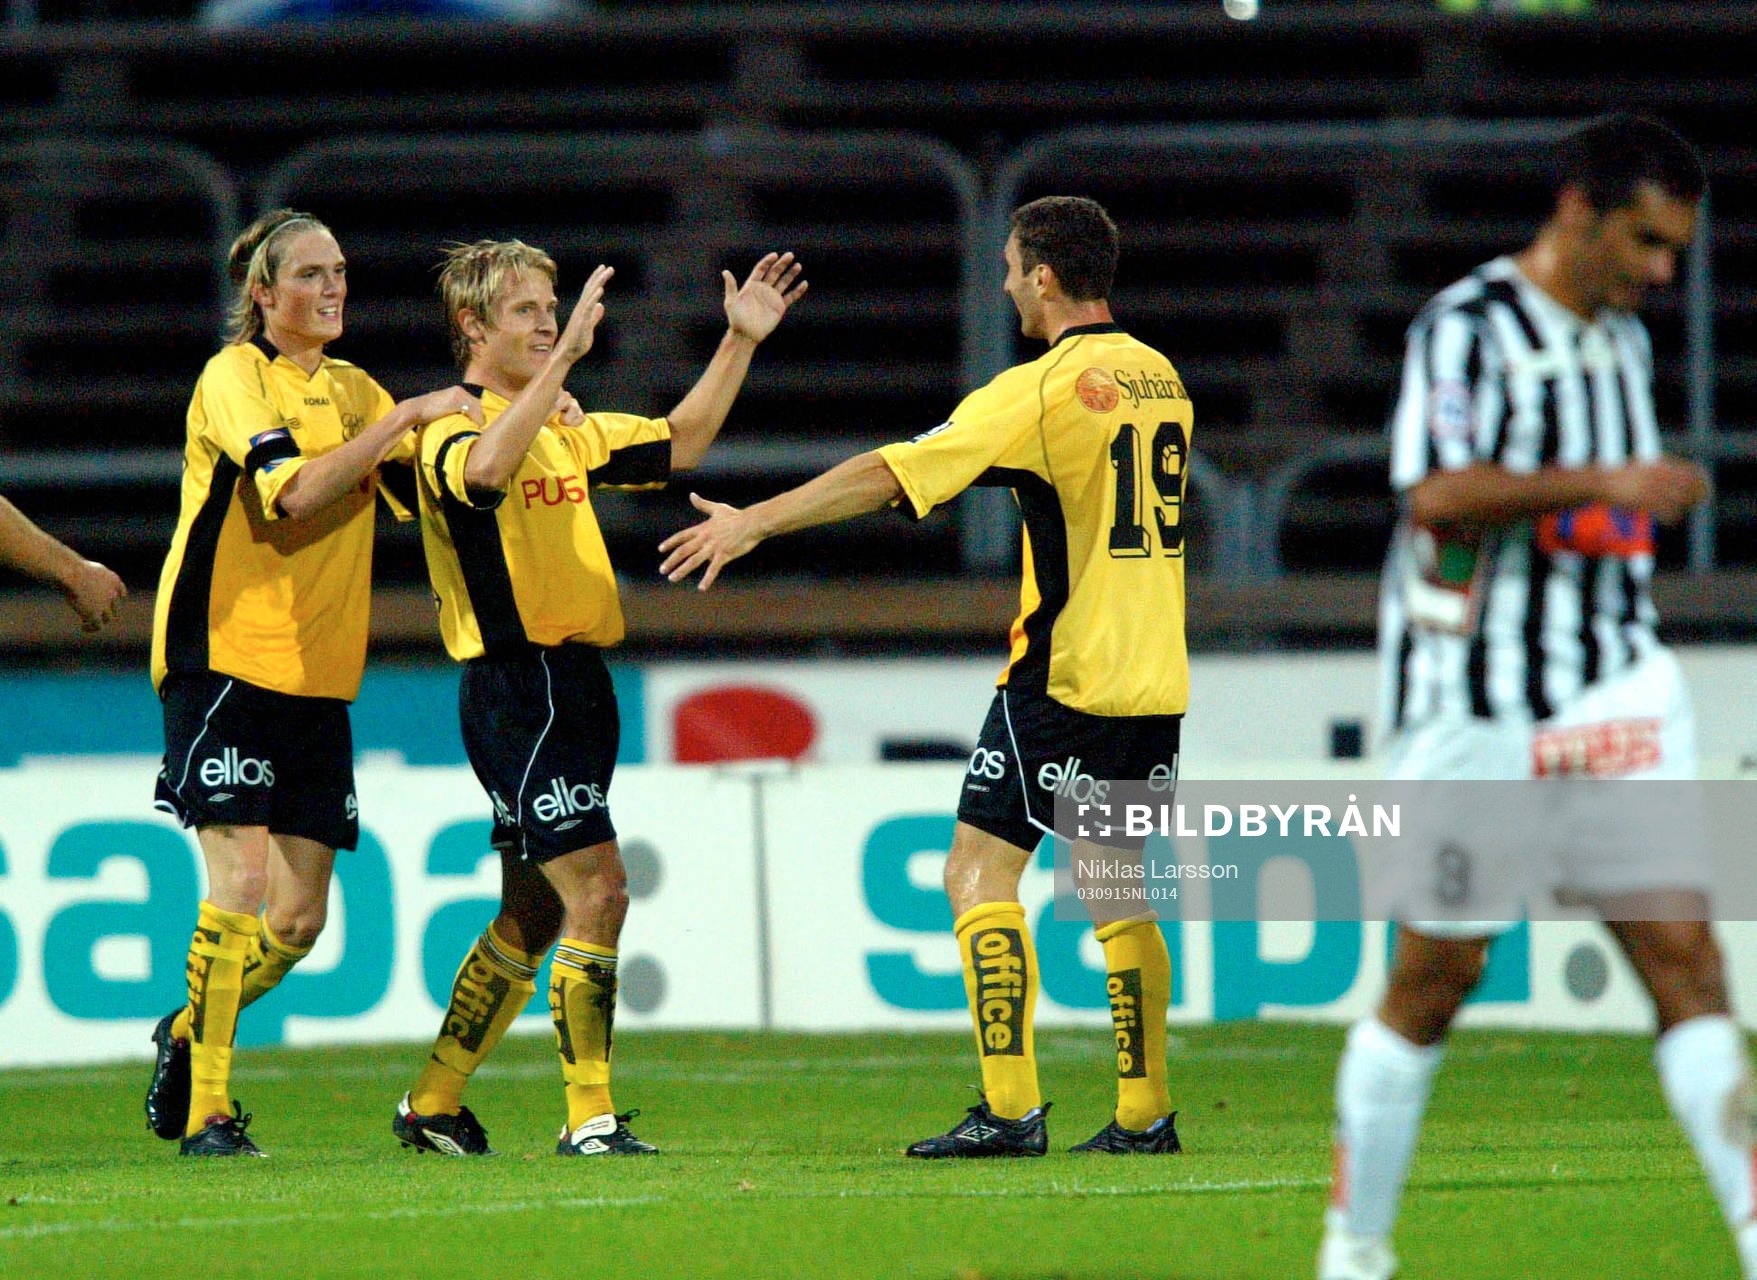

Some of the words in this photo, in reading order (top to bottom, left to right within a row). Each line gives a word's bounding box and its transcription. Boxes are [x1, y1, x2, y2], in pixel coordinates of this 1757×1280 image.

[1114, 369, 1188, 409] Sjuhära
[1109, 422, 1187, 558] 19
[200, 747, 275, 787] ellos
[1038, 756, 1110, 808] ellos
[533, 776, 605, 822] ellos
[976, 931, 1022, 1049] office
[1106, 976, 1135, 1073] office
